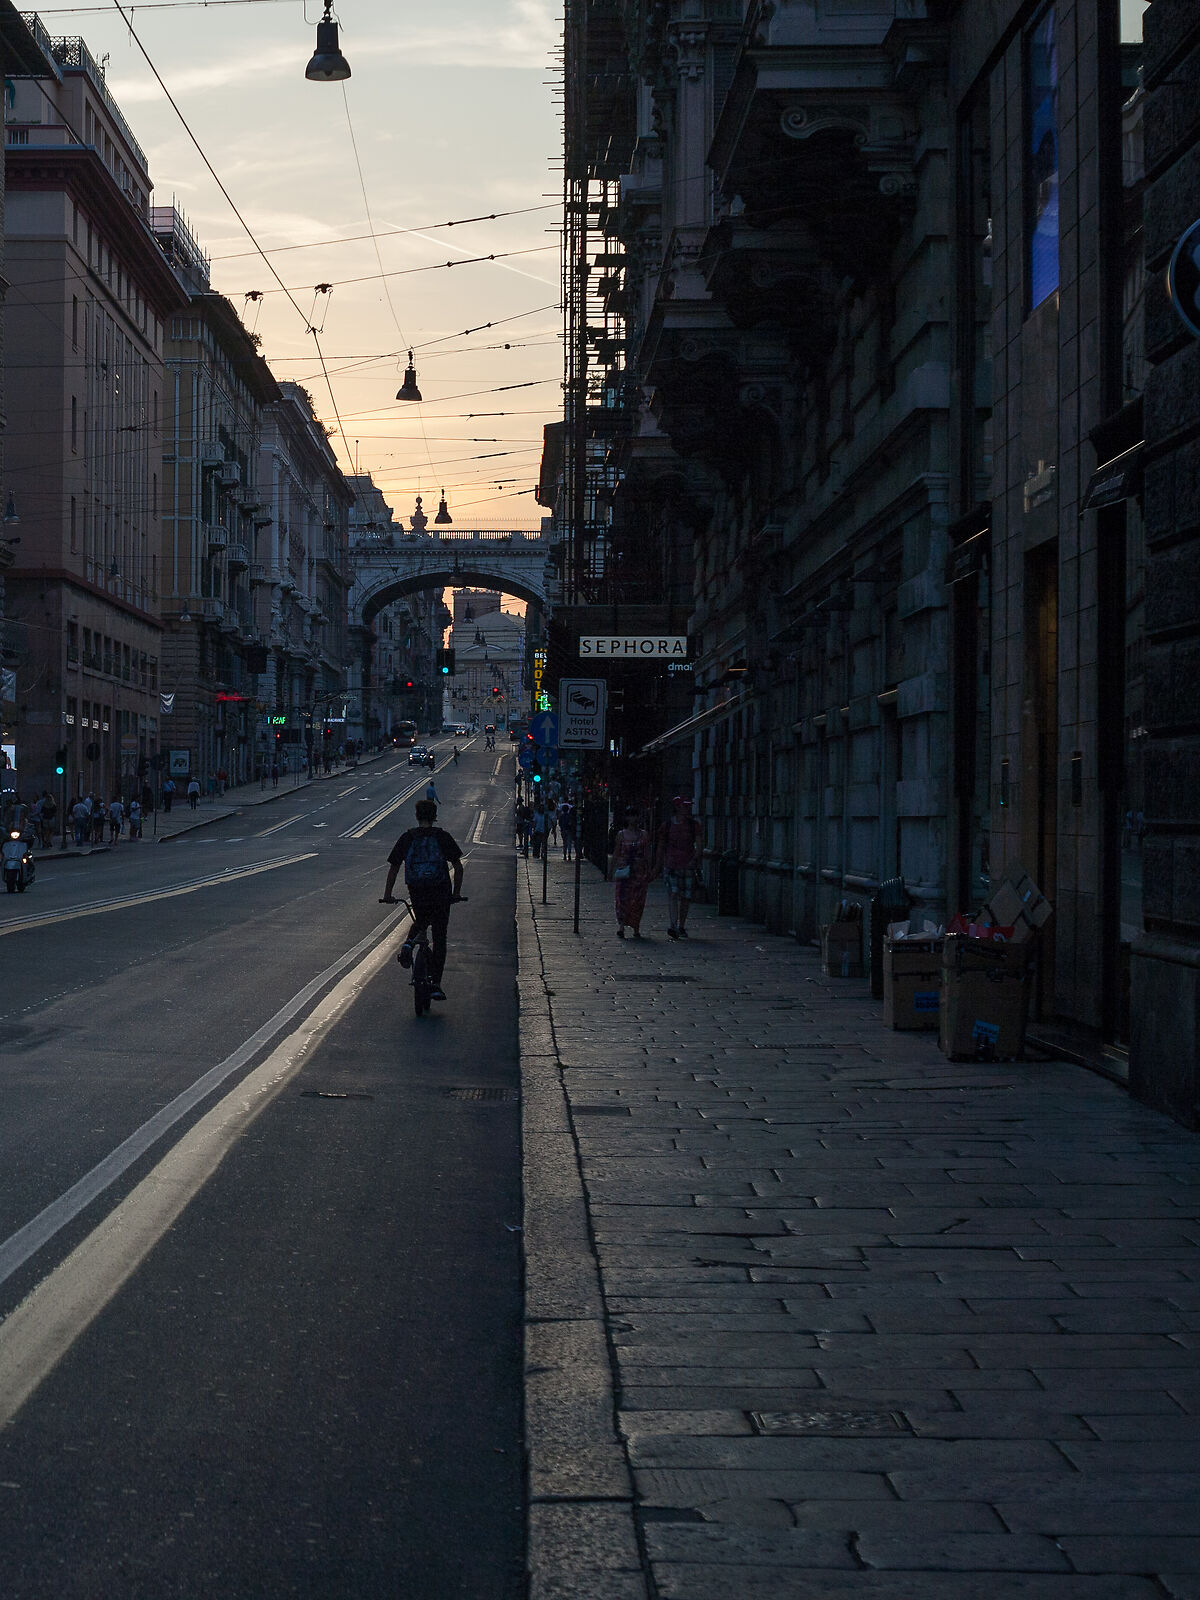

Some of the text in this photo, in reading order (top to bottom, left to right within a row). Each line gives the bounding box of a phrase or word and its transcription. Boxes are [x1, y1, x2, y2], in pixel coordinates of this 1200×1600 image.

[582, 639, 684, 655] SEPHORA
[667, 661, 697, 672] dmai
[570, 717, 594, 726] Hotel
[564, 728, 599, 737] ASTRO
